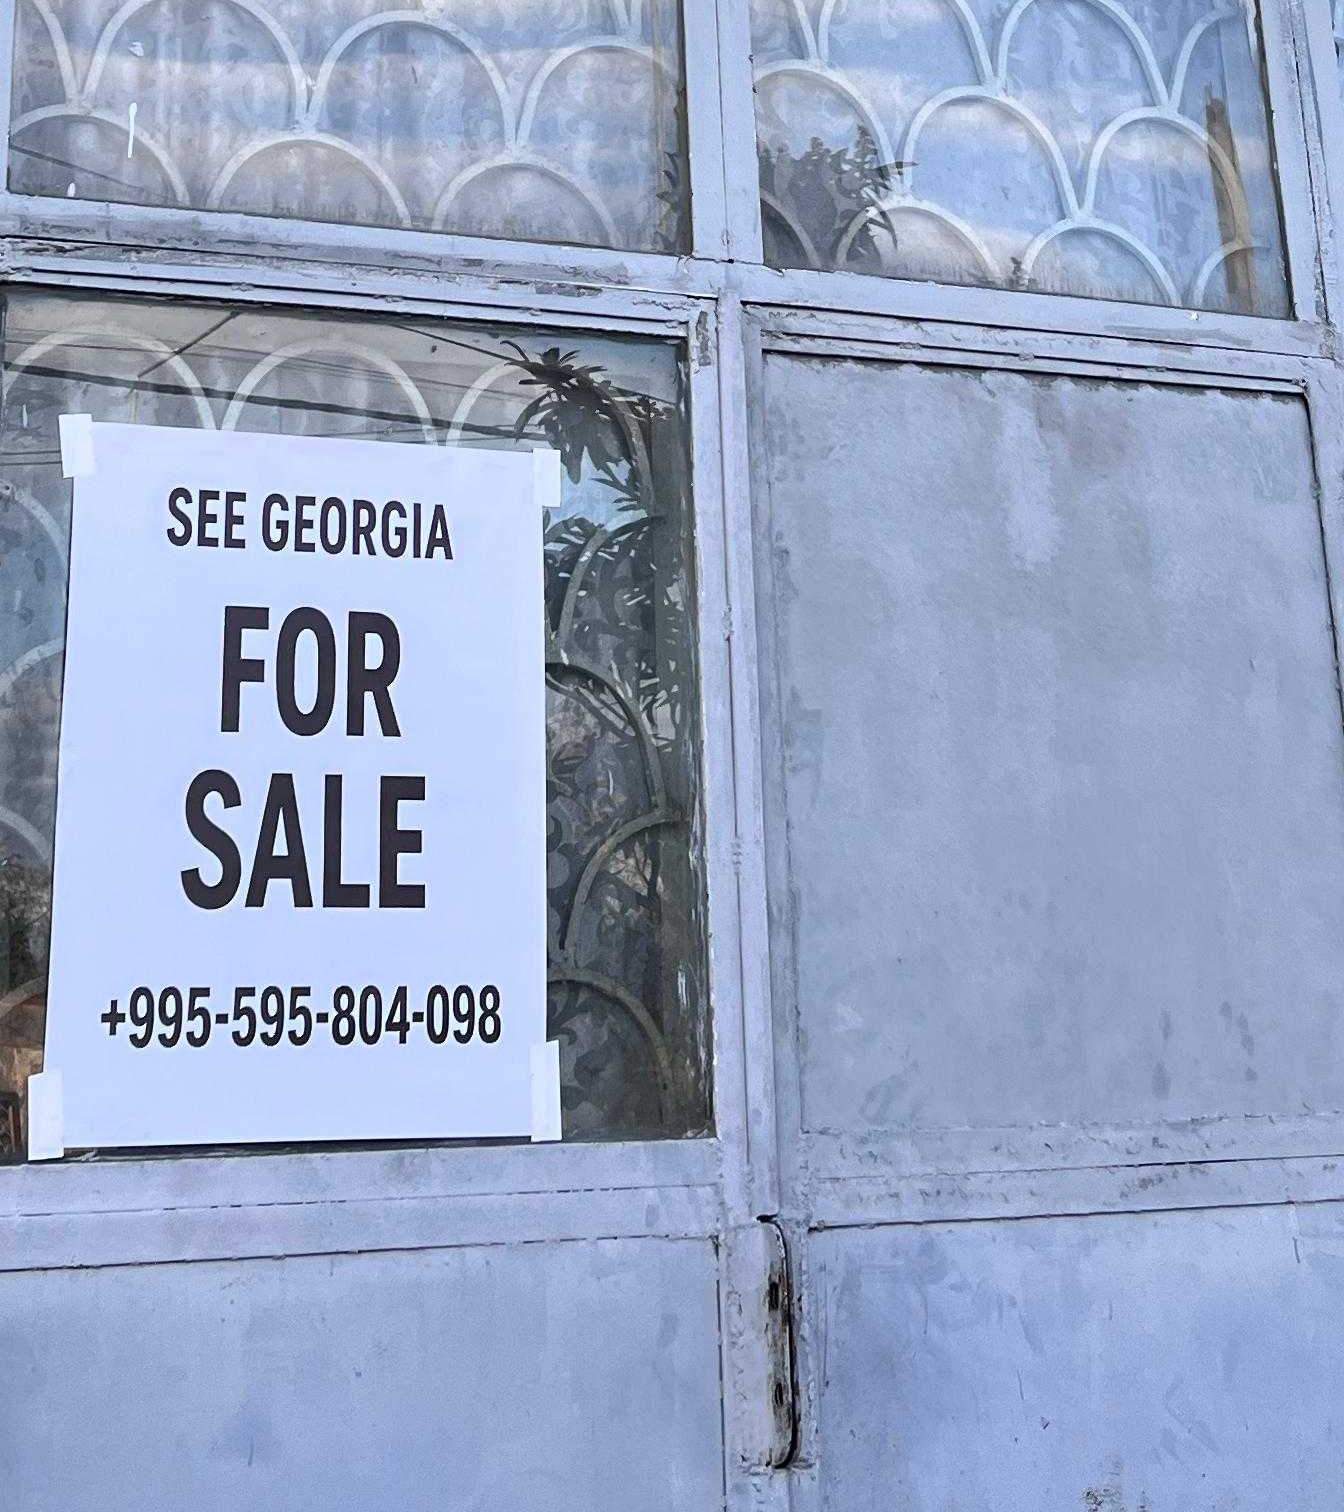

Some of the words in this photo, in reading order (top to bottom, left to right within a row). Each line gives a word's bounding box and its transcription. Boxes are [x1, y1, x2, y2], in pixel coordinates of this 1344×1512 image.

[166, 487, 247, 549] SEE
[261, 493, 454, 561] GEORGIA
[220, 605, 402, 738] FOR
[180, 769, 426, 910] SALE
[100, 984, 502, 1049] +995-595-804-098
